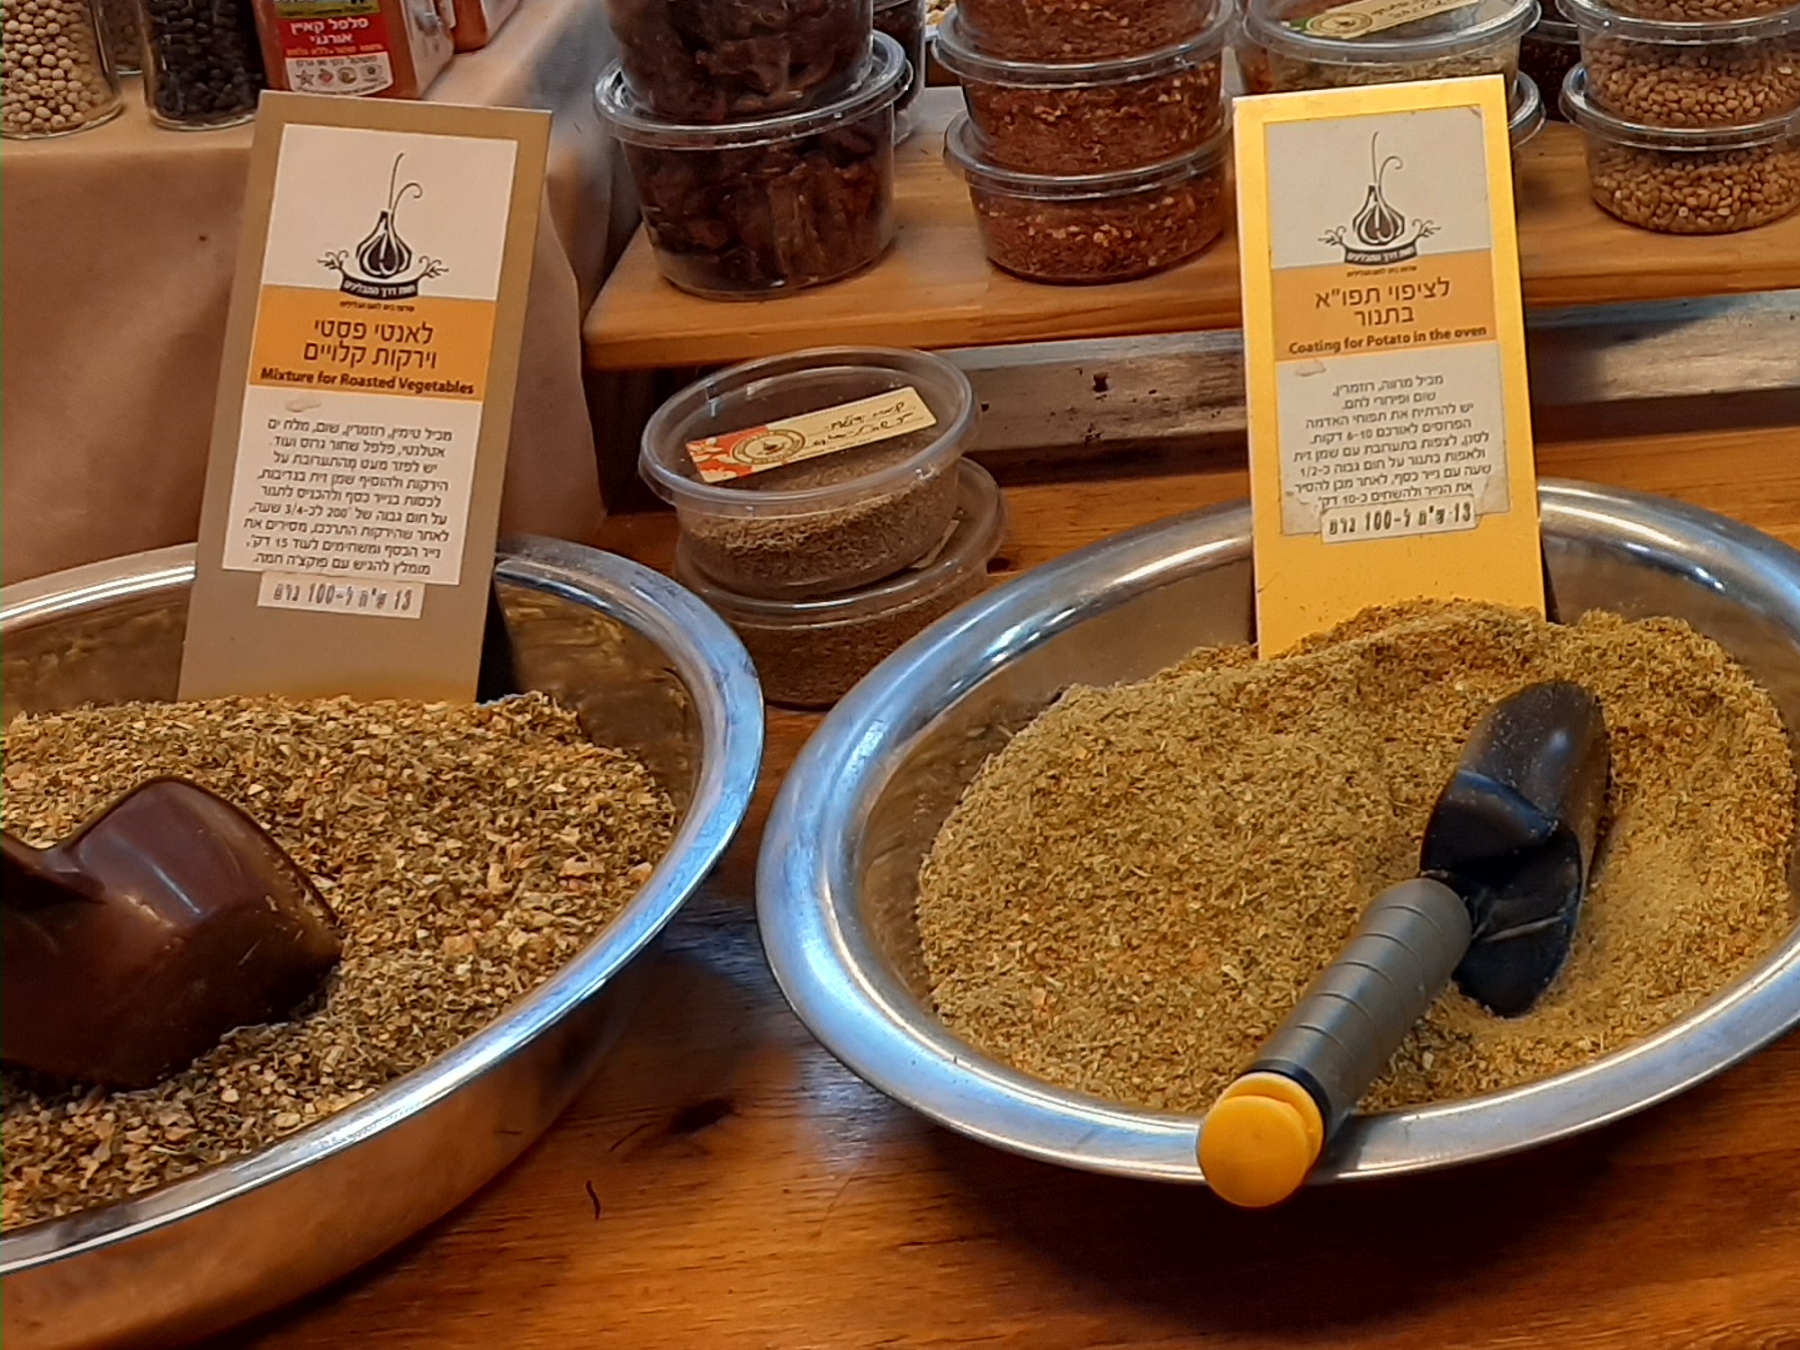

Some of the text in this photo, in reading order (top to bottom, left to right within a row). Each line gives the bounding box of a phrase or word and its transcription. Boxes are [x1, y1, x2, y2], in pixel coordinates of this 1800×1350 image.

[1387, 275, 1450, 301] לציפוי
[1353, 305, 1414, 326] בתנור
[313, 319, 434, 345] לאנטי פסטי
[1288, 326, 1487, 355] Coating for Potato in the oven
[302, 338, 437, 372] וירקות קלויים
[259, 366, 474, 395] Mixture for Roasted Vegetables
[1414, 374, 1444, 387] מכיל
[1412, 390, 1436, 403] שום
[1305, 401, 1474, 429] יש להרתיח את תפוחי האדמה
[266, 417, 281, 430] ים
[282, 417, 310, 432] מלח
[310, 421, 340, 434] שום,
[423, 426, 453, 442] מכיל
[1419, 433, 1458, 450] לצפות
[299, 436, 326, 450] גרוס
[328, 438, 360, 452] שחור
[362, 438, 396, 455] פלפל
[1362, 439, 1417, 455] בתערובת
[272, 449, 290, 464] על
[1292, 450, 1312, 462] זית
[1314, 447, 1339, 462] שמן
[1341, 445, 1361, 457] עם
[1442, 446, 1486, 463] ולאפות
[359, 458, 388, 471] מעט
[390, 459, 420, 473] לפזר
[1362, 458, 1386, 471] חום
[1387, 455, 1405, 468] על
[1406, 452, 1441, 466] בתנור
[422, 463, 438, 474] יש
[1333, 460, 1360, 475] גבוה
[1420, 468, 1441, 480] נייר
[1442, 466, 1461, 479] עם
[1463, 463, 1492, 476] שעה
[307, 471, 328, 484] זית
[329, 472, 356, 487] שמן
[357, 474, 404, 489] ולהוסיף
[404, 478, 449, 492] הירקות
[1355, 472, 1388, 487] לאחר
[1293, 478, 1330, 493] להסיר
[260, 484, 441, 508] לכסות בנייר כסף ולהכניס לתנור
[1364, 507, 1411, 531] ל-100
[1448, 501, 1471, 523] 13
[242, 517, 263, 529] את
[264, 518, 308, 533] מסירים
[1328, 516, 1356, 535] גרם
[359, 525, 414, 540] שהירקות
[415, 528, 450, 542] לאחר
[274, 537, 288, 548] 15
[291, 537, 319, 550] לעוד
[383, 544, 419, 558] הכסף
[421, 546, 441, 559] נייר
[330, 557, 350, 569] עם
[352, 558, 390, 572] להגיש
[392, 559, 431, 576] מומלץ
[272, 582, 300, 602] גרם
[393, 588, 413, 611] 13
